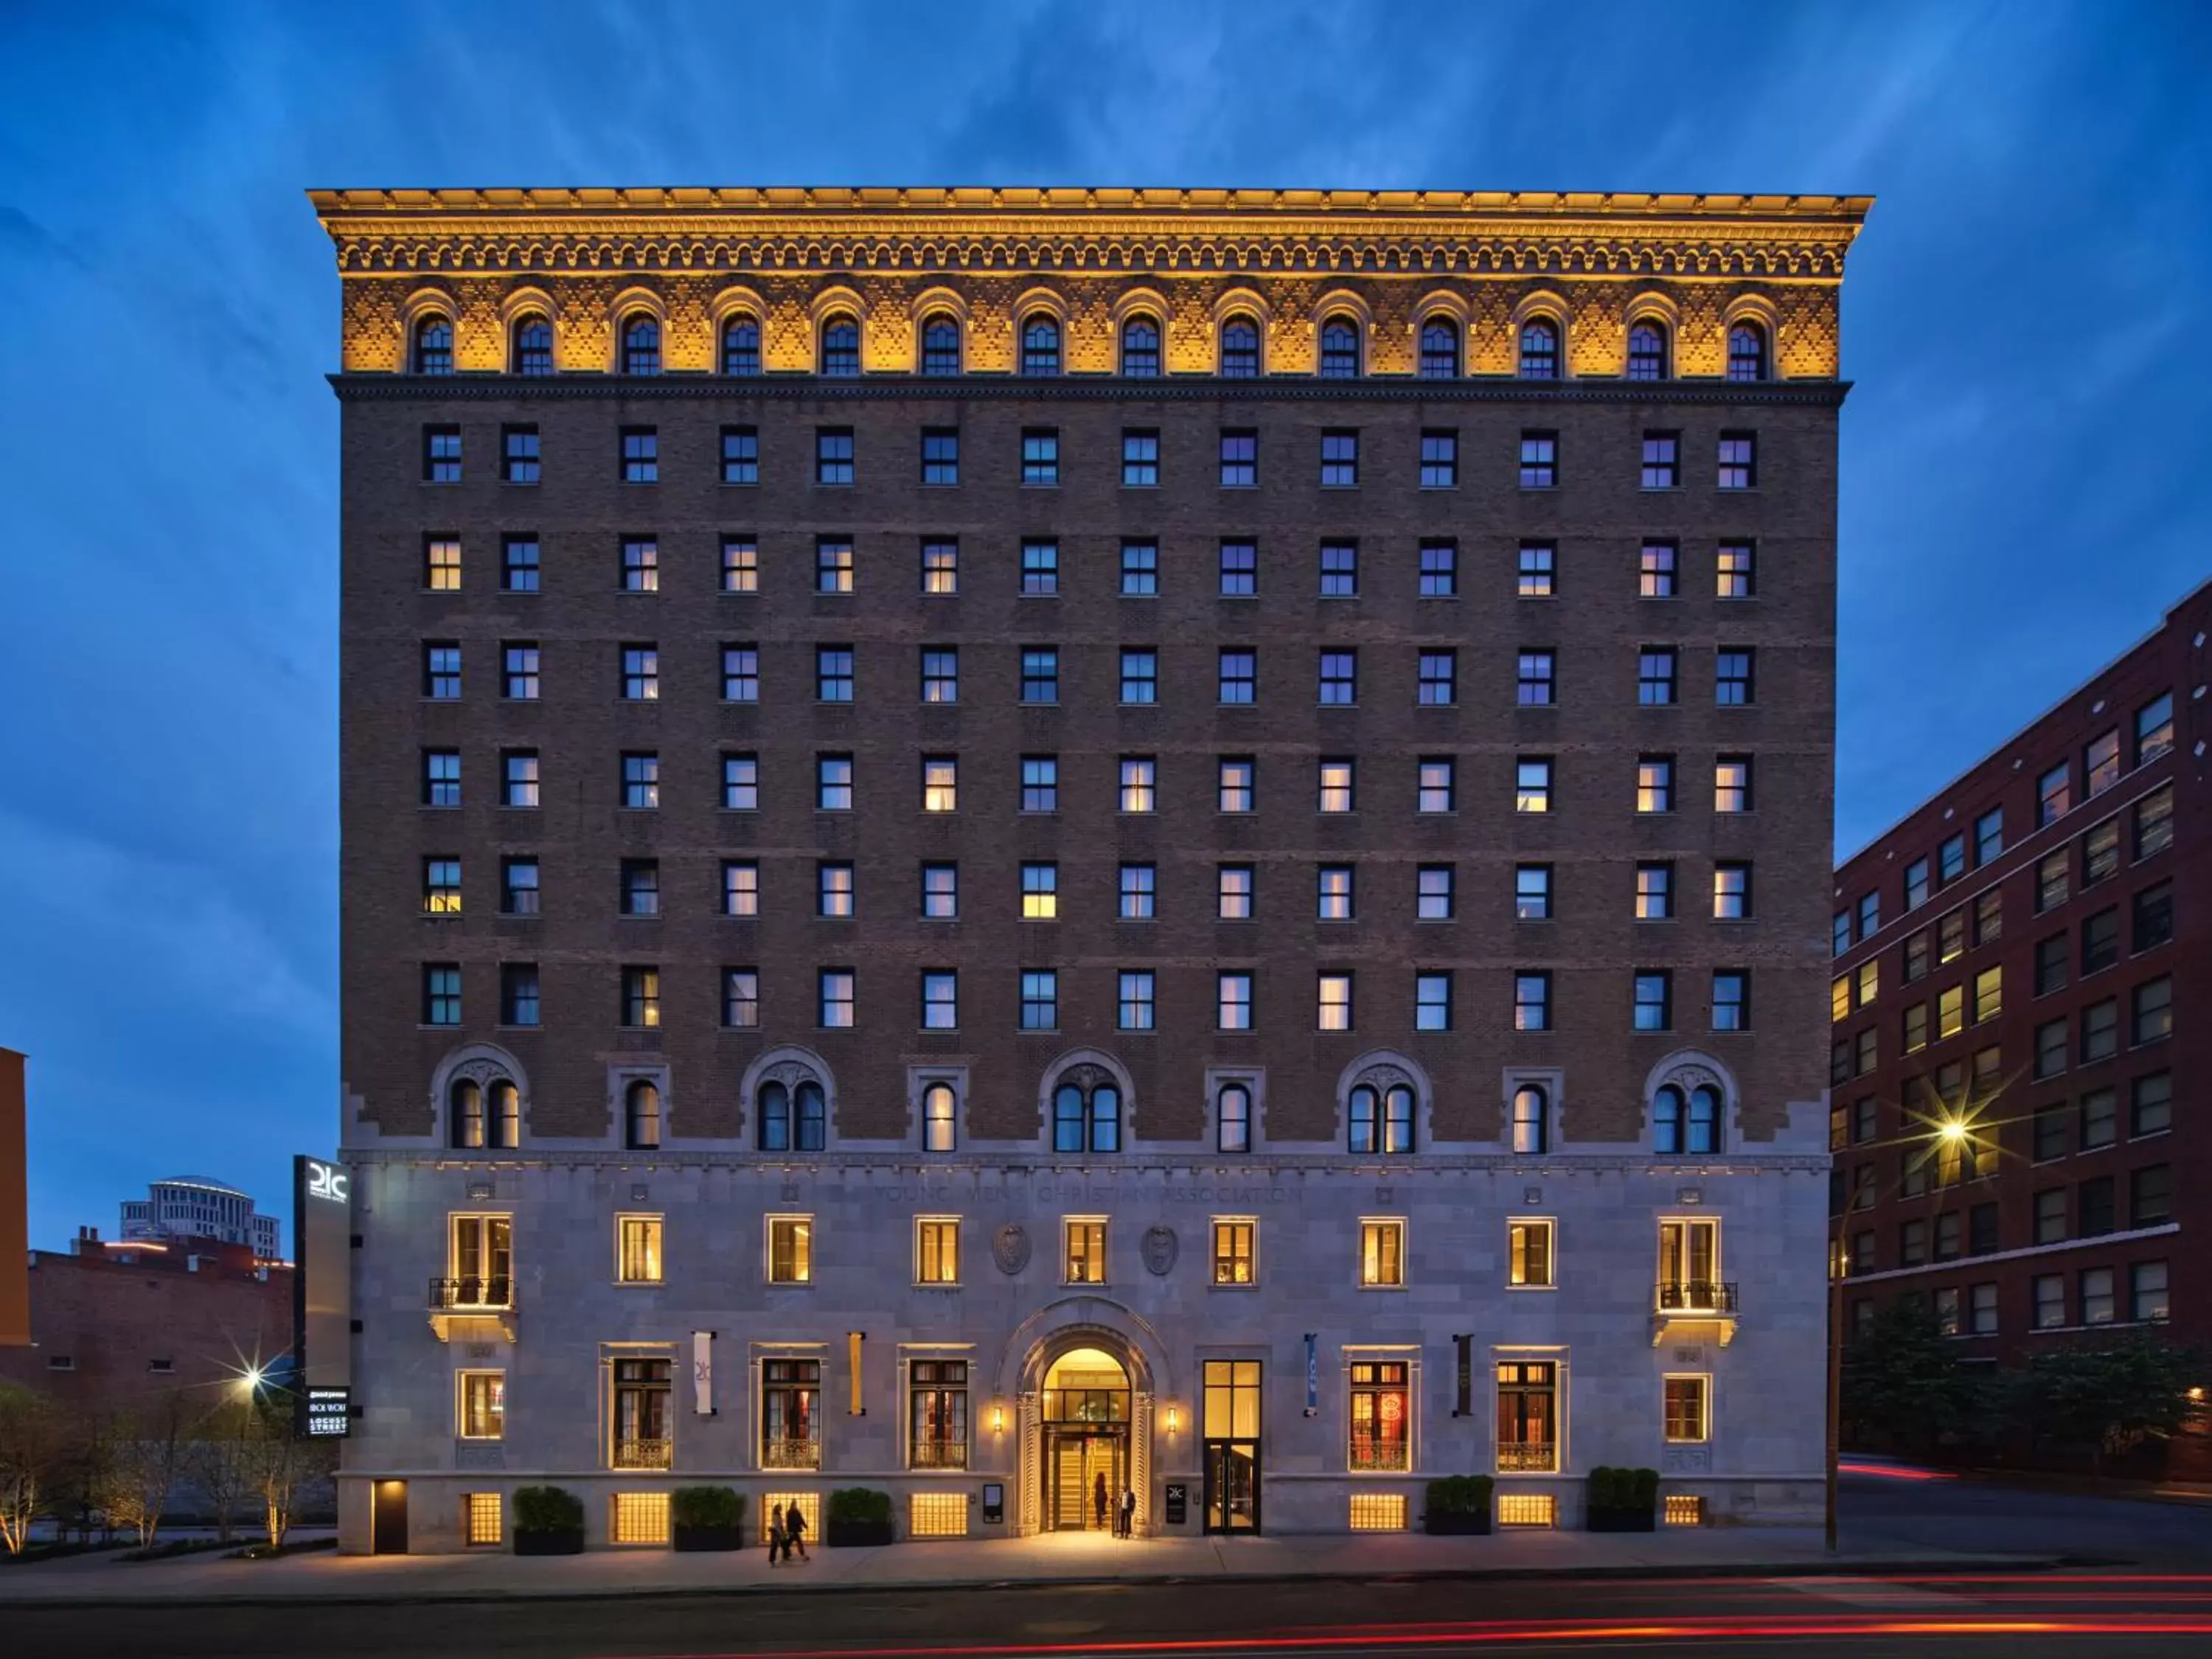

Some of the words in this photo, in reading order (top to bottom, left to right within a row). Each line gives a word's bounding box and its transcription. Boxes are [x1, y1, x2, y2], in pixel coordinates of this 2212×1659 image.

[873, 1186, 950, 1203] YOUNG
[1038, 1186, 1147, 1203] CHRISTIAN
[1161, 1187, 1302, 1203] ASSOCIATION
